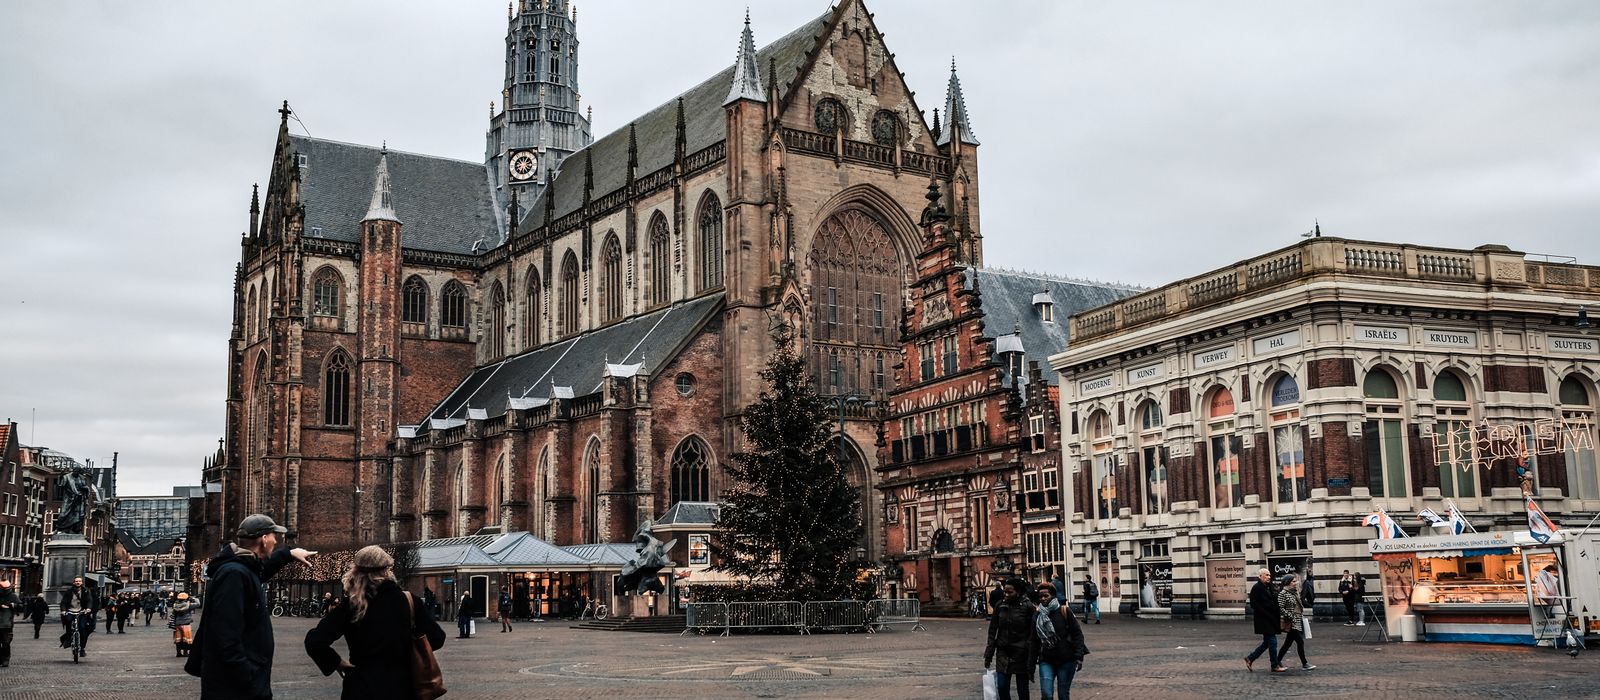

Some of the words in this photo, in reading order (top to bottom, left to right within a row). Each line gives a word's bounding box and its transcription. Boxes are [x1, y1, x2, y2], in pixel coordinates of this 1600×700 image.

[1365, 329, 1397, 339] ISRAËLS
[1430, 333, 1469, 343] KRUYDER
[1270, 338, 1284, 348] HAL
[1554, 340, 1592, 351] SLUYTERS
[1202, 350, 1228, 364] VERWEY
[1137, 368, 1156, 379] KUNST
[1084, 378, 1111, 391] MODERNE
